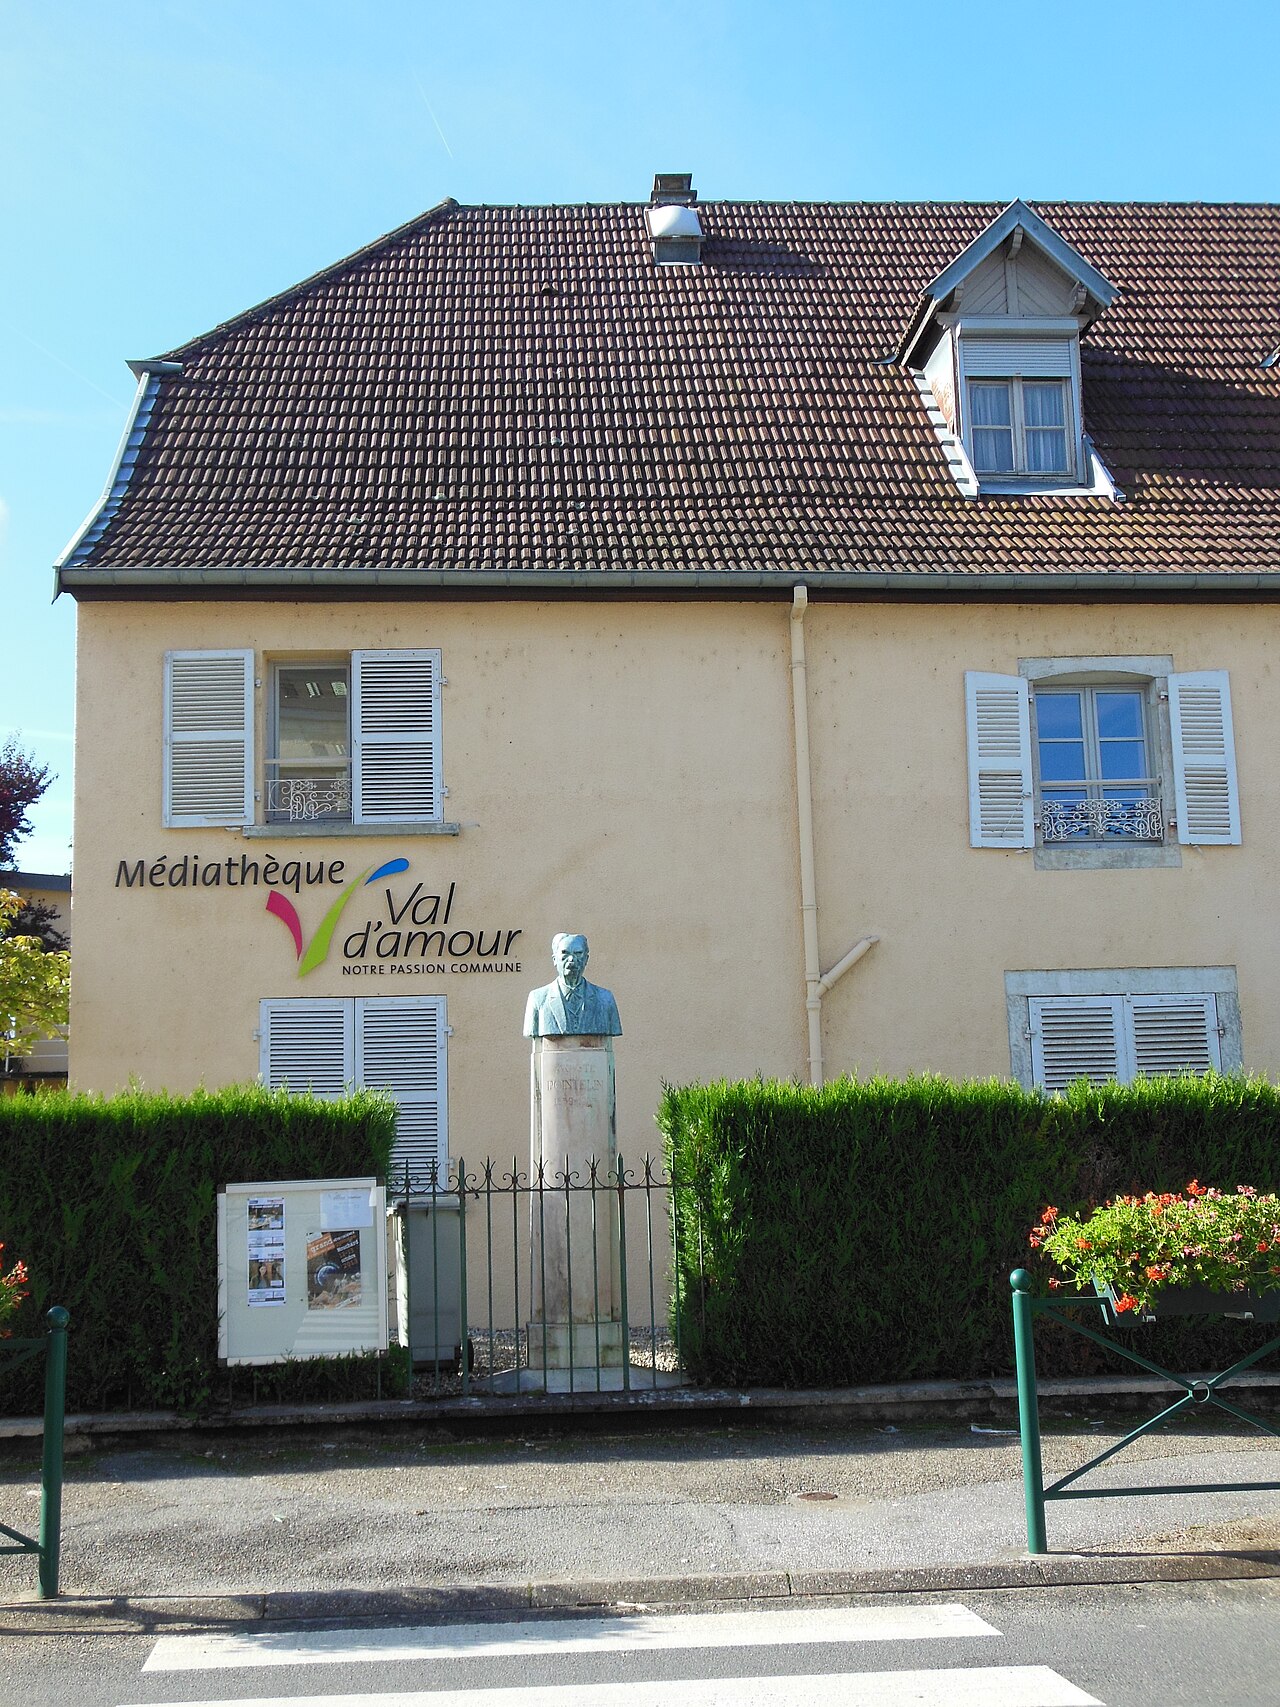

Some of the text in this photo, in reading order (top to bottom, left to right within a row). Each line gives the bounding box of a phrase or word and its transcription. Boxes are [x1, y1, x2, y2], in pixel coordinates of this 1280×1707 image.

[115, 854, 345, 893] Médiathèque
[385, 882, 455, 925] Val
[343, 920, 522, 959] d’amour
[342, 962, 522, 975] NOTRE PASSION COMMUNE
